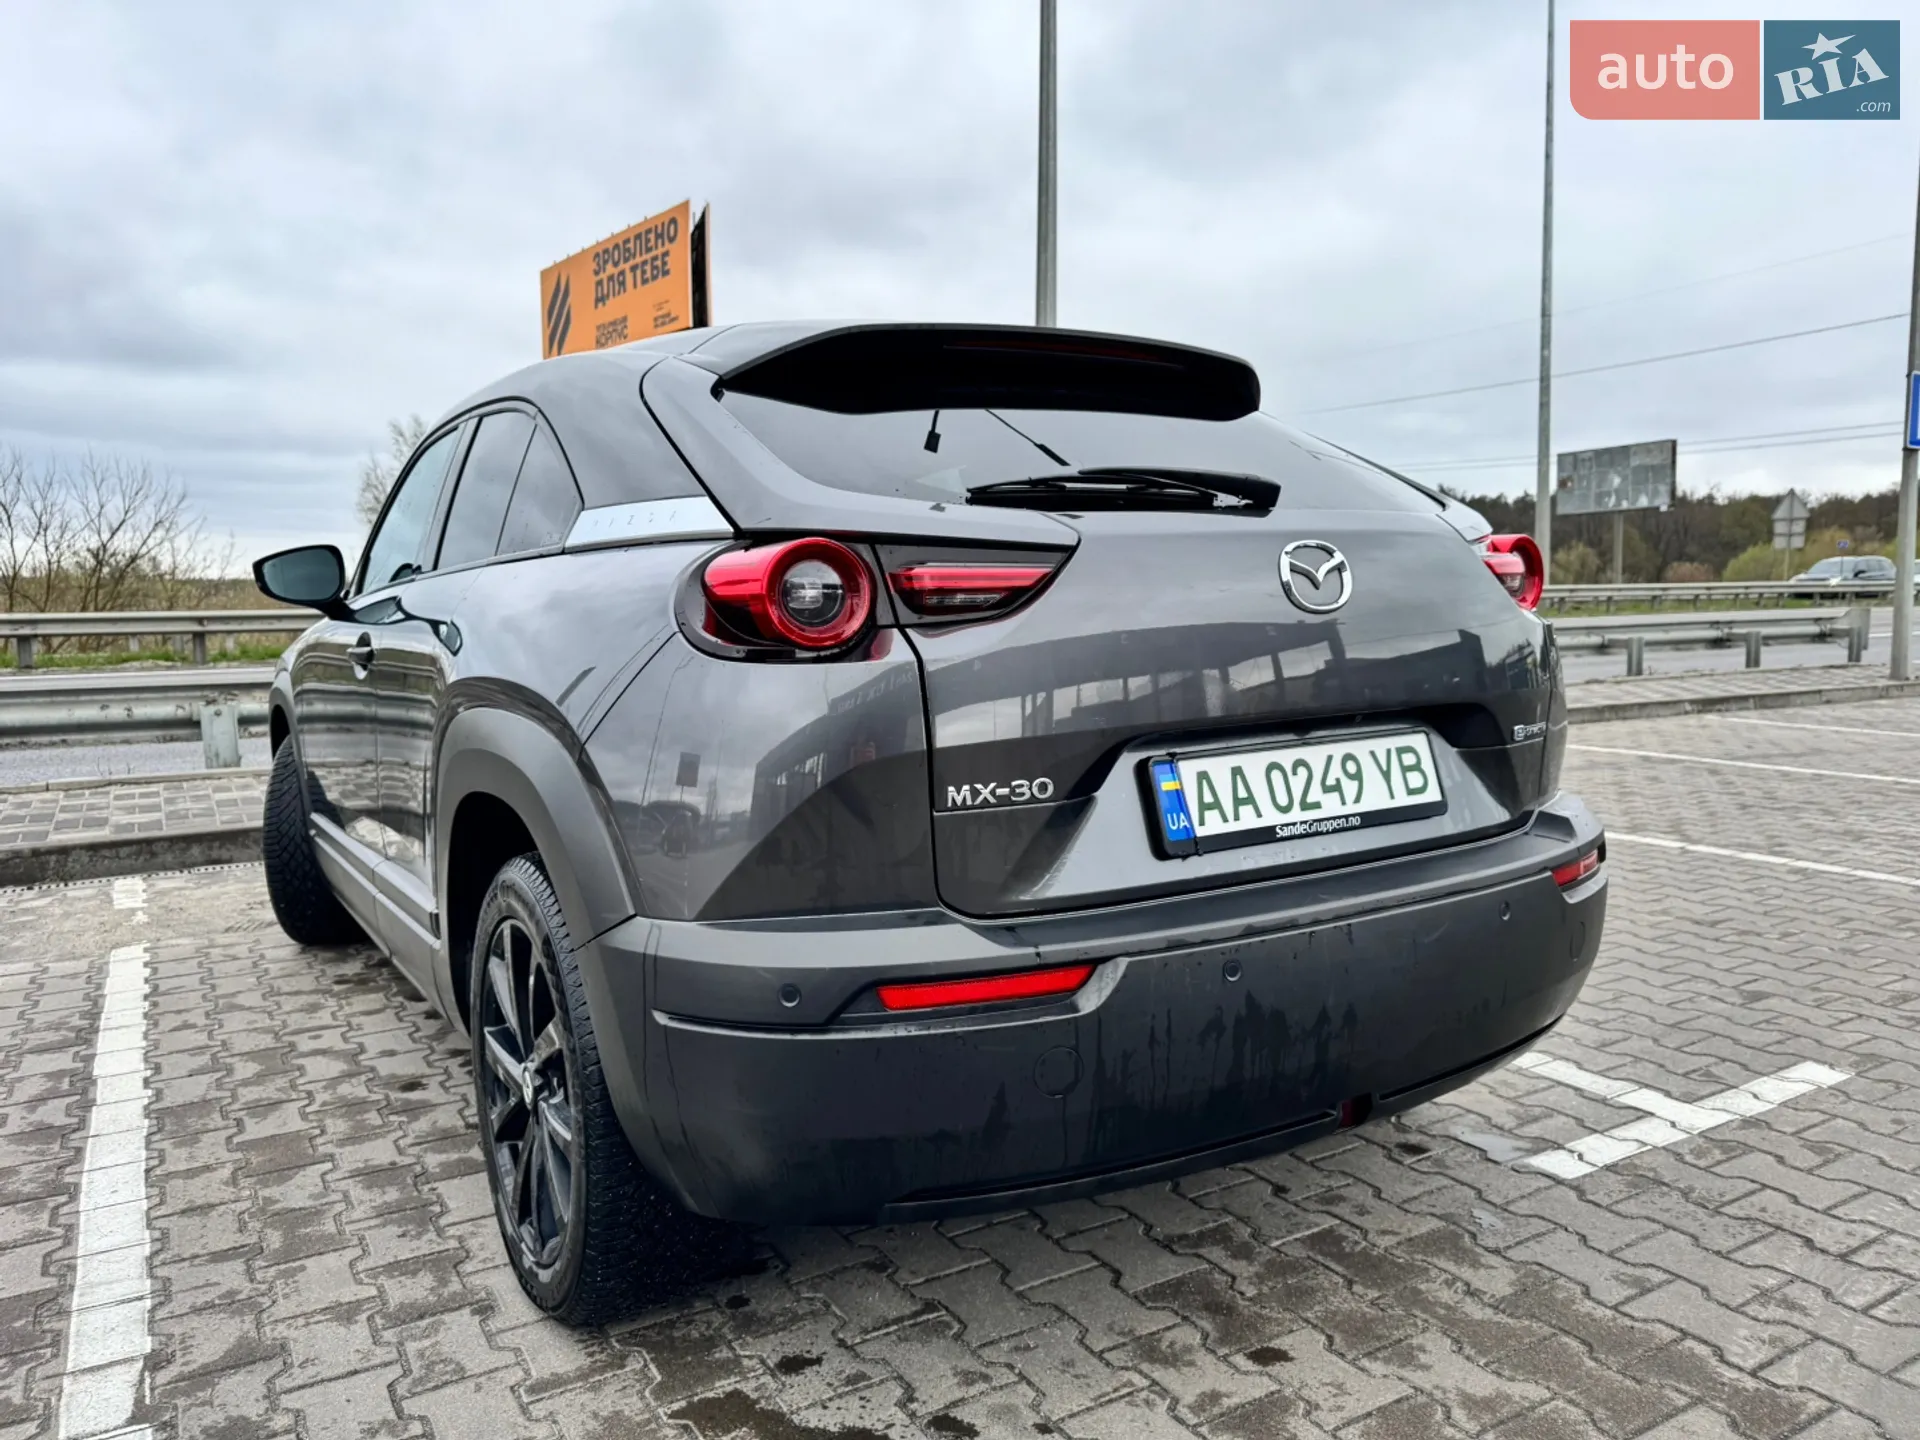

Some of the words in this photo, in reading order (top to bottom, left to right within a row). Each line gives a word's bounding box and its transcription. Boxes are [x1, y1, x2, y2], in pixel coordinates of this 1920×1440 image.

[592, 216, 679, 277] ЗРОБЛЕНО
[594, 272, 627, 310] ДЛЯ
[630, 250, 671, 290] ТЕБЕ
[947, 777, 1054, 807] MX-30
[1195, 765, 1263, 827] AA
[1265, 752, 1364, 815] 0249
[1369, 745, 1430, 800] YB
[1166, 813, 1191, 831] UA
[1275, 814, 1361, 839] SandeGruppen.no
